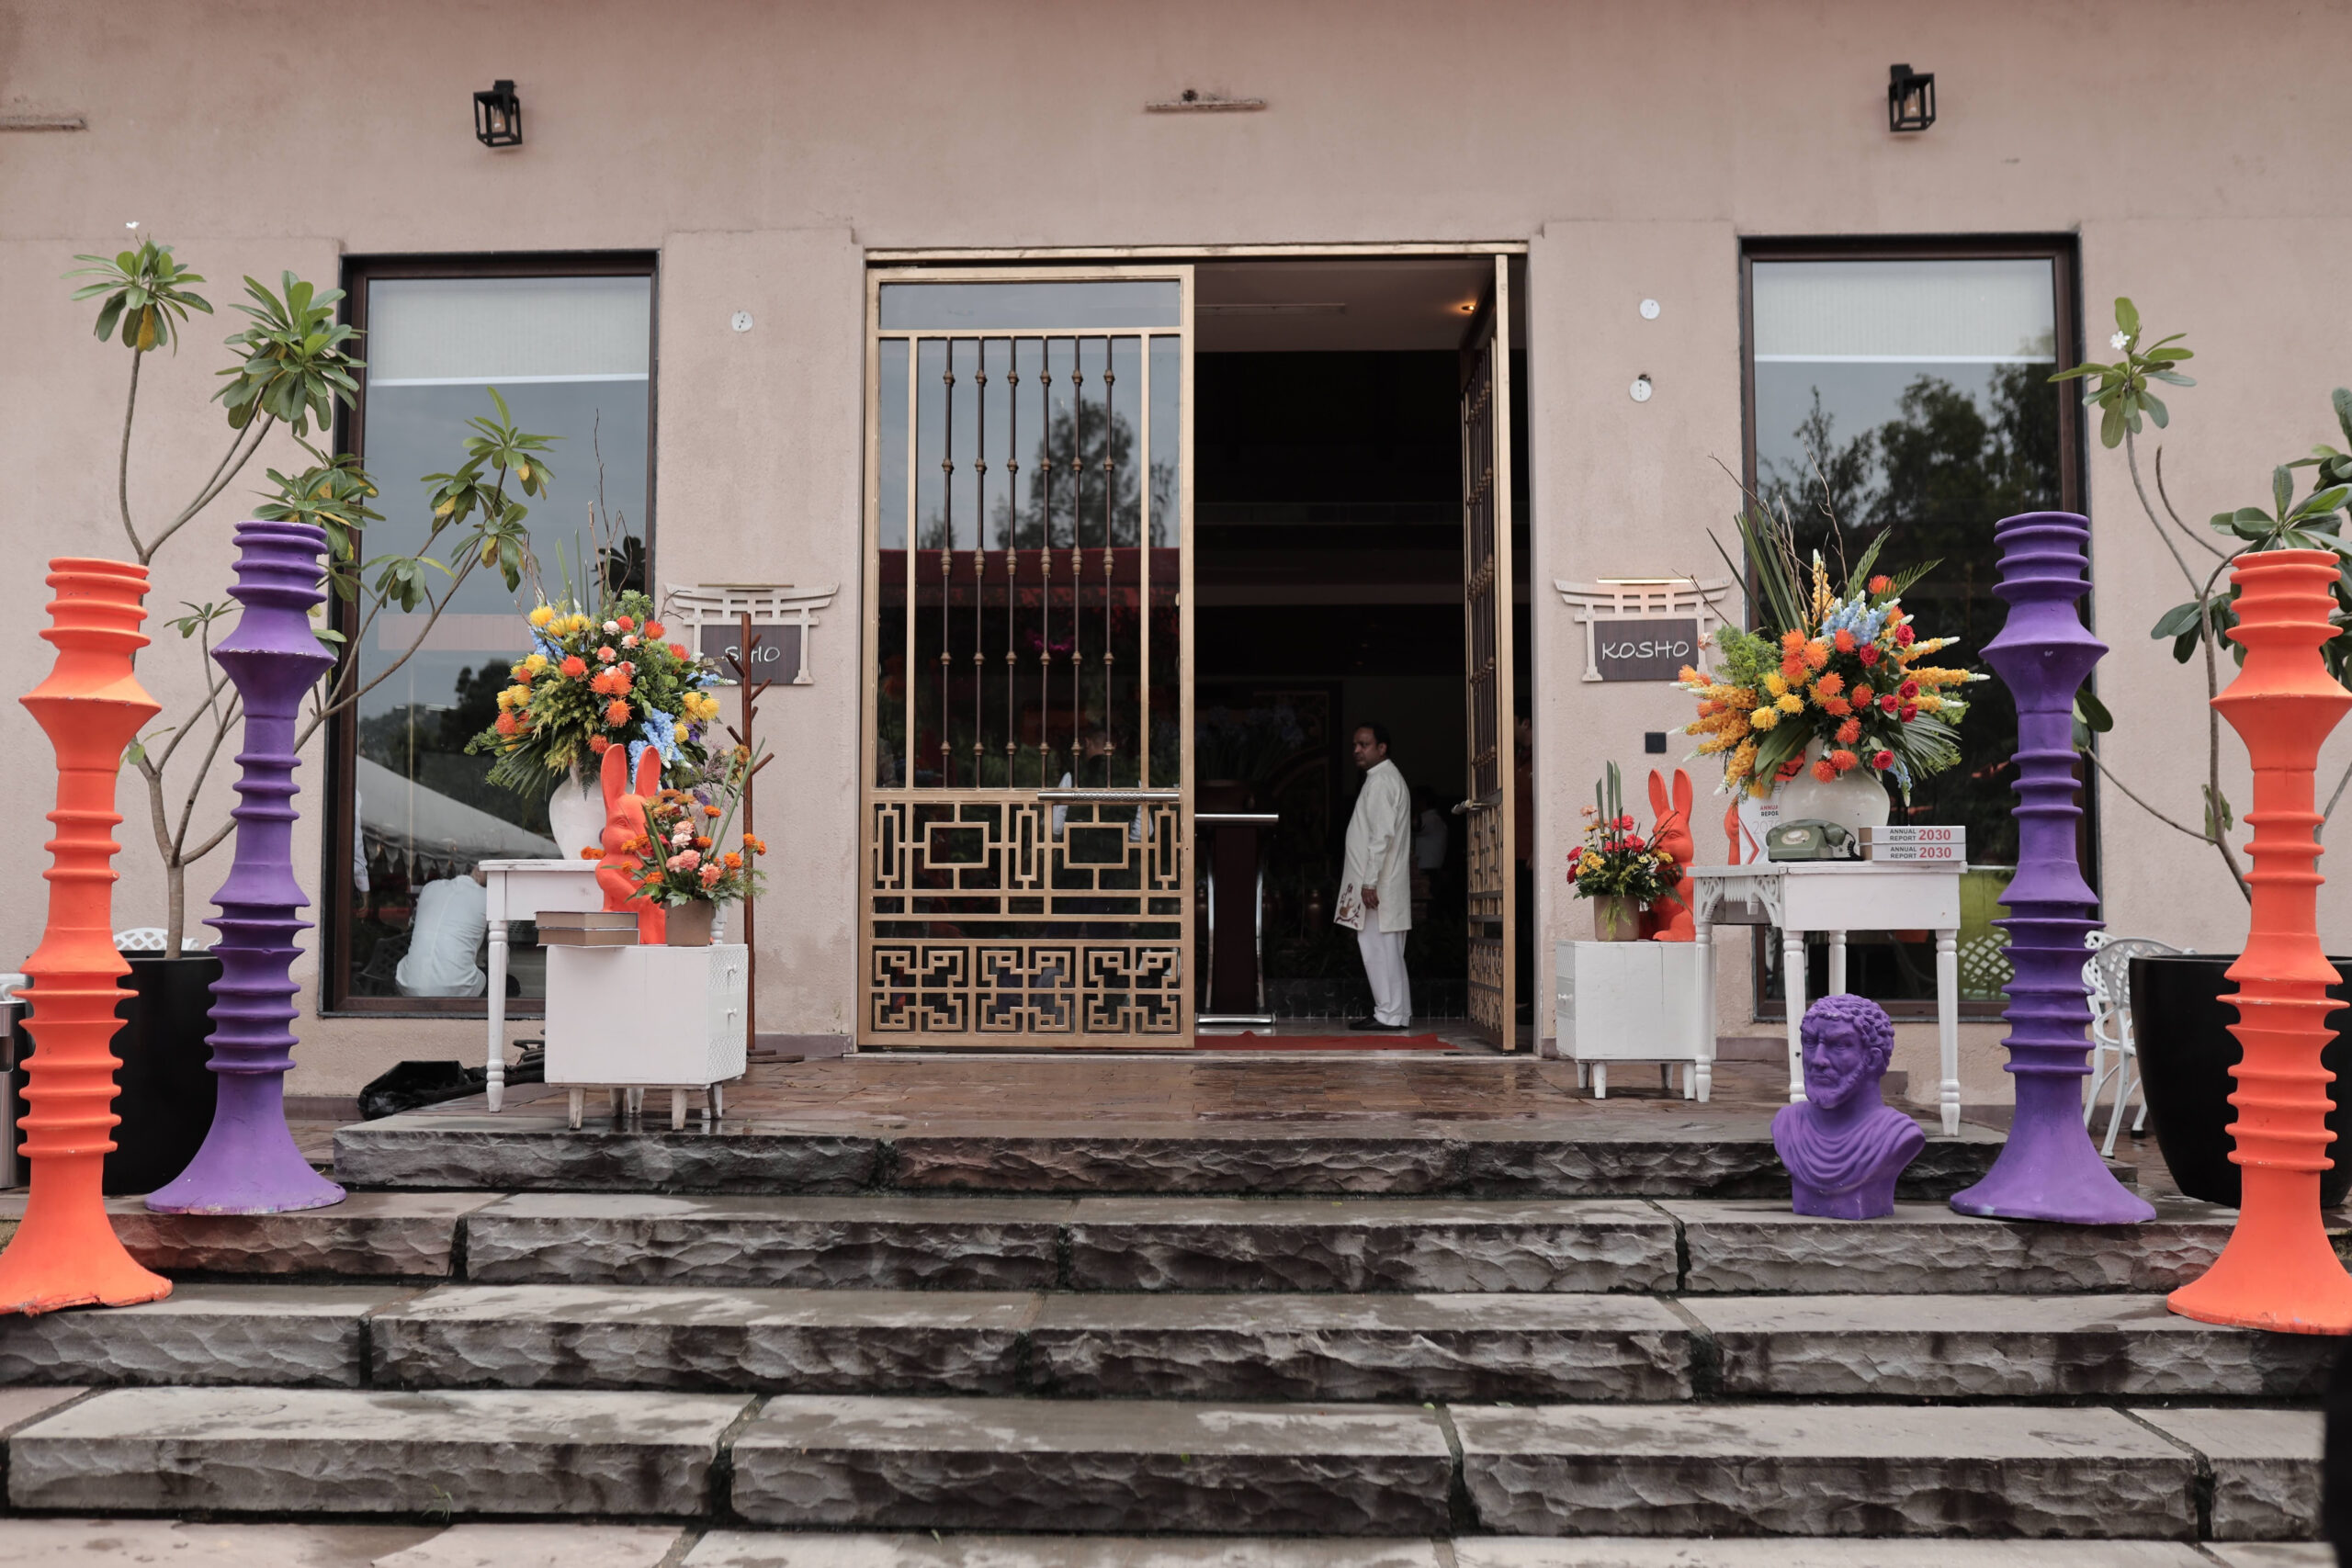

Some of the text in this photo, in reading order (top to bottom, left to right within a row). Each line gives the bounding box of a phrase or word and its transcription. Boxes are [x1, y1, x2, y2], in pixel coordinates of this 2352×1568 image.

[1601, 639, 1690, 660] KOSHO
[1918, 829, 1951, 840] 2030
[1919, 846, 1952, 858] 2030
